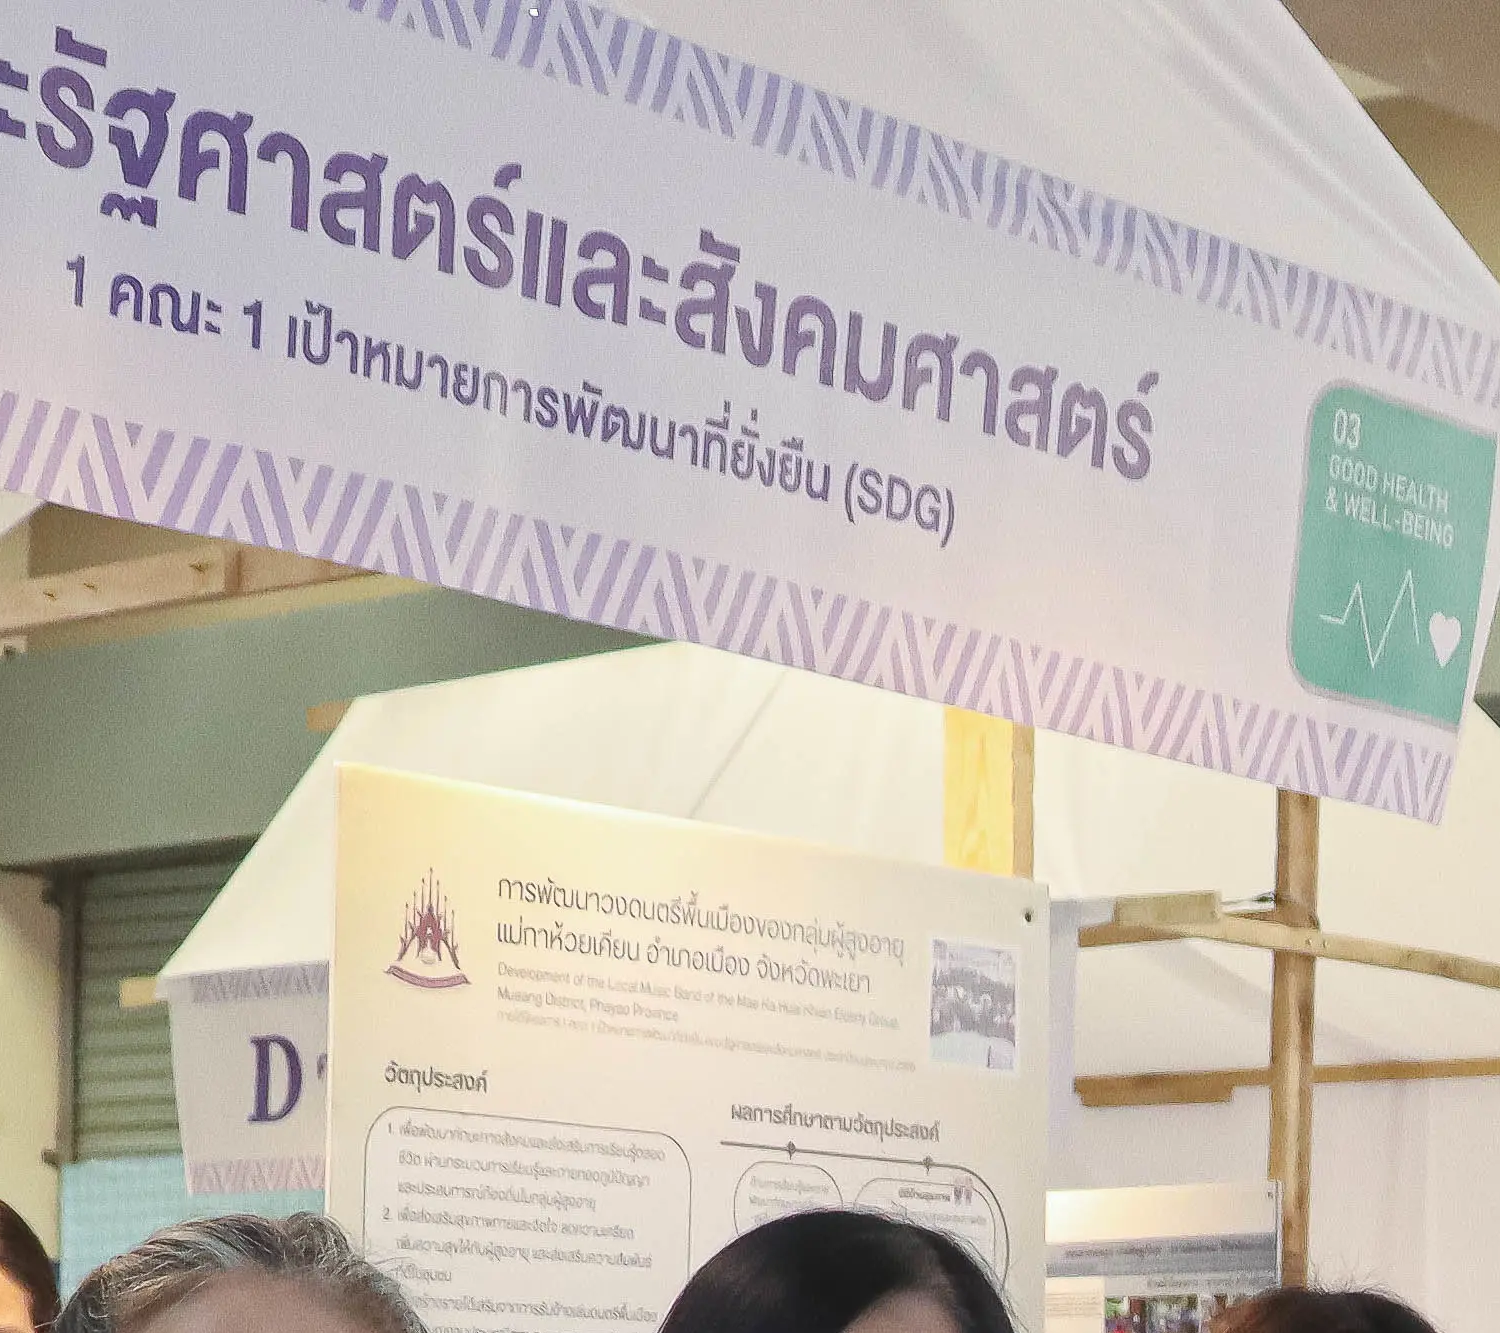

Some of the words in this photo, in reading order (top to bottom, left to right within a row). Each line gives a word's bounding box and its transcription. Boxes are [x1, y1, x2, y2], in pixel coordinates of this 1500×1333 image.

[66, 255, 86, 307] 1
[108, 272, 223, 336] คณะ
[242, 300, 264, 350] 1
[287, 299, 831, 502] เป้าหมายการพัฒนาที่ยั่งยืน
[845, 461, 956, 548] (SDG)
[1332, 407, 1362, 451] 03
[1328, 454, 1378, 491] GOOD
[1382, 468, 1450, 514] HEALTH
[1324, 487, 1338, 513] &
[1343, 491, 1455, 550] WELL-BEING
[247, 1034, 304, 1123] D
